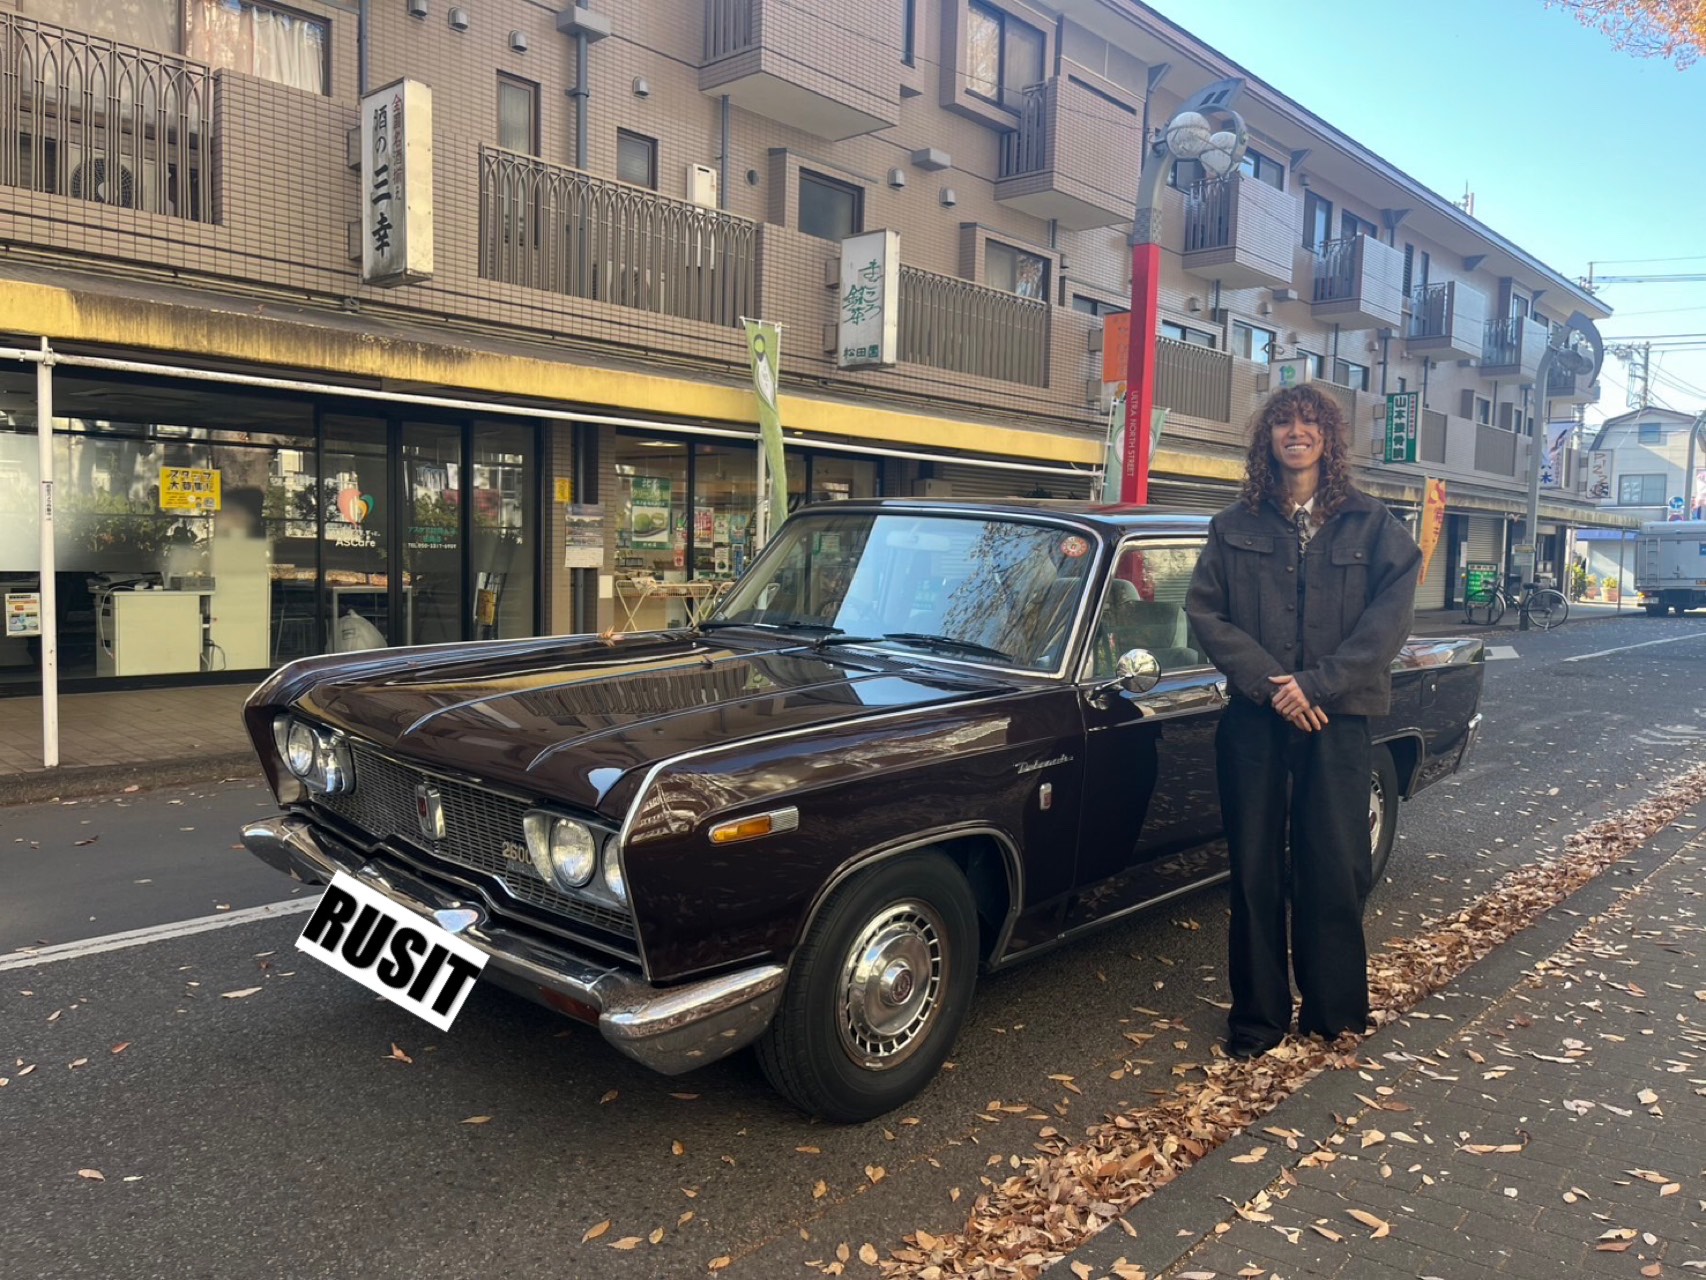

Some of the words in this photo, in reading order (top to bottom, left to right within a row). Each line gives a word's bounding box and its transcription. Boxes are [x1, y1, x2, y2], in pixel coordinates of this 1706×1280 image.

[371, 104, 393, 258] 酒の三幸
[1130, 390, 1139, 417] ULTRA
[1128, 418, 1138, 448] NORTH
[1127, 449, 1136, 478] STREET
